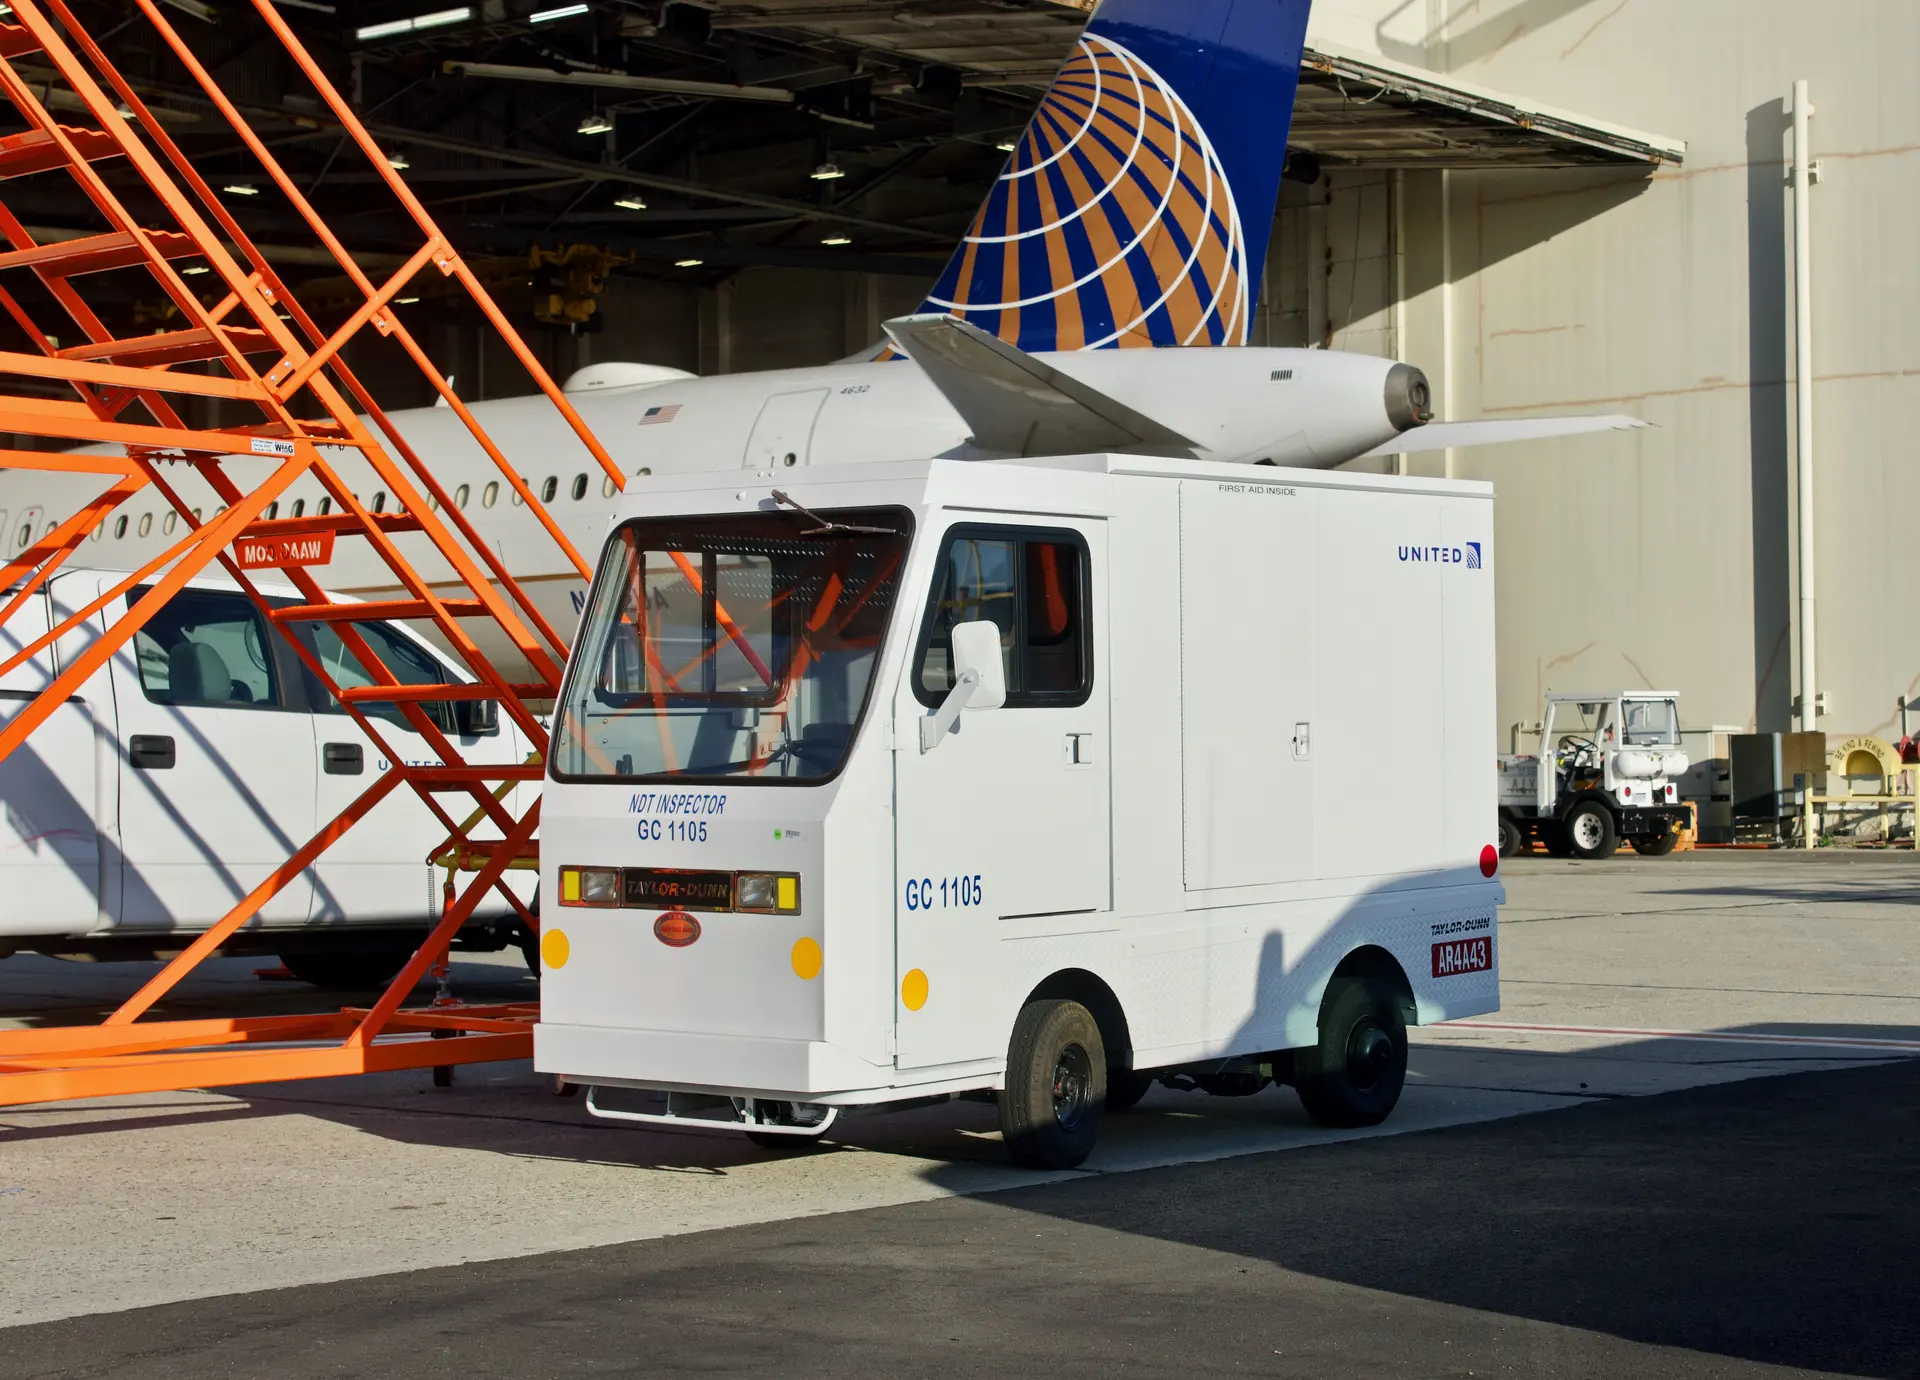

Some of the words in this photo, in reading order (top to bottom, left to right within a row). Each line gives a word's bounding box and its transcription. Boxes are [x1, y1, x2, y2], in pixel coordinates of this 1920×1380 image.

[840, 384, 870, 395] 4632
[1218, 484, 1245, 493] FIRST
[1248, 485, 1264, 494] AID
[1266, 486, 1297, 496] INSIDE
[1398, 545, 1463, 563] UNITED
[1834, 750, 1845, 760] BE
[1842, 739, 1856, 751] KIND
[1864, 739, 1885, 759] REWIND
[628, 793, 654, 814] NDT
[655, 794, 727, 815] INSPECTOR
[637, 819, 662, 842] GC
[668, 820, 708, 843] 1105
[627, 880, 729, 899] TAYLOR-DUNN
[905, 878, 933, 911] GC
[940, 875, 983, 910] 1105
[1431, 917, 1490, 936] TAYLOR-DUNN
[1438, 940, 1487, 974] AR4A43
